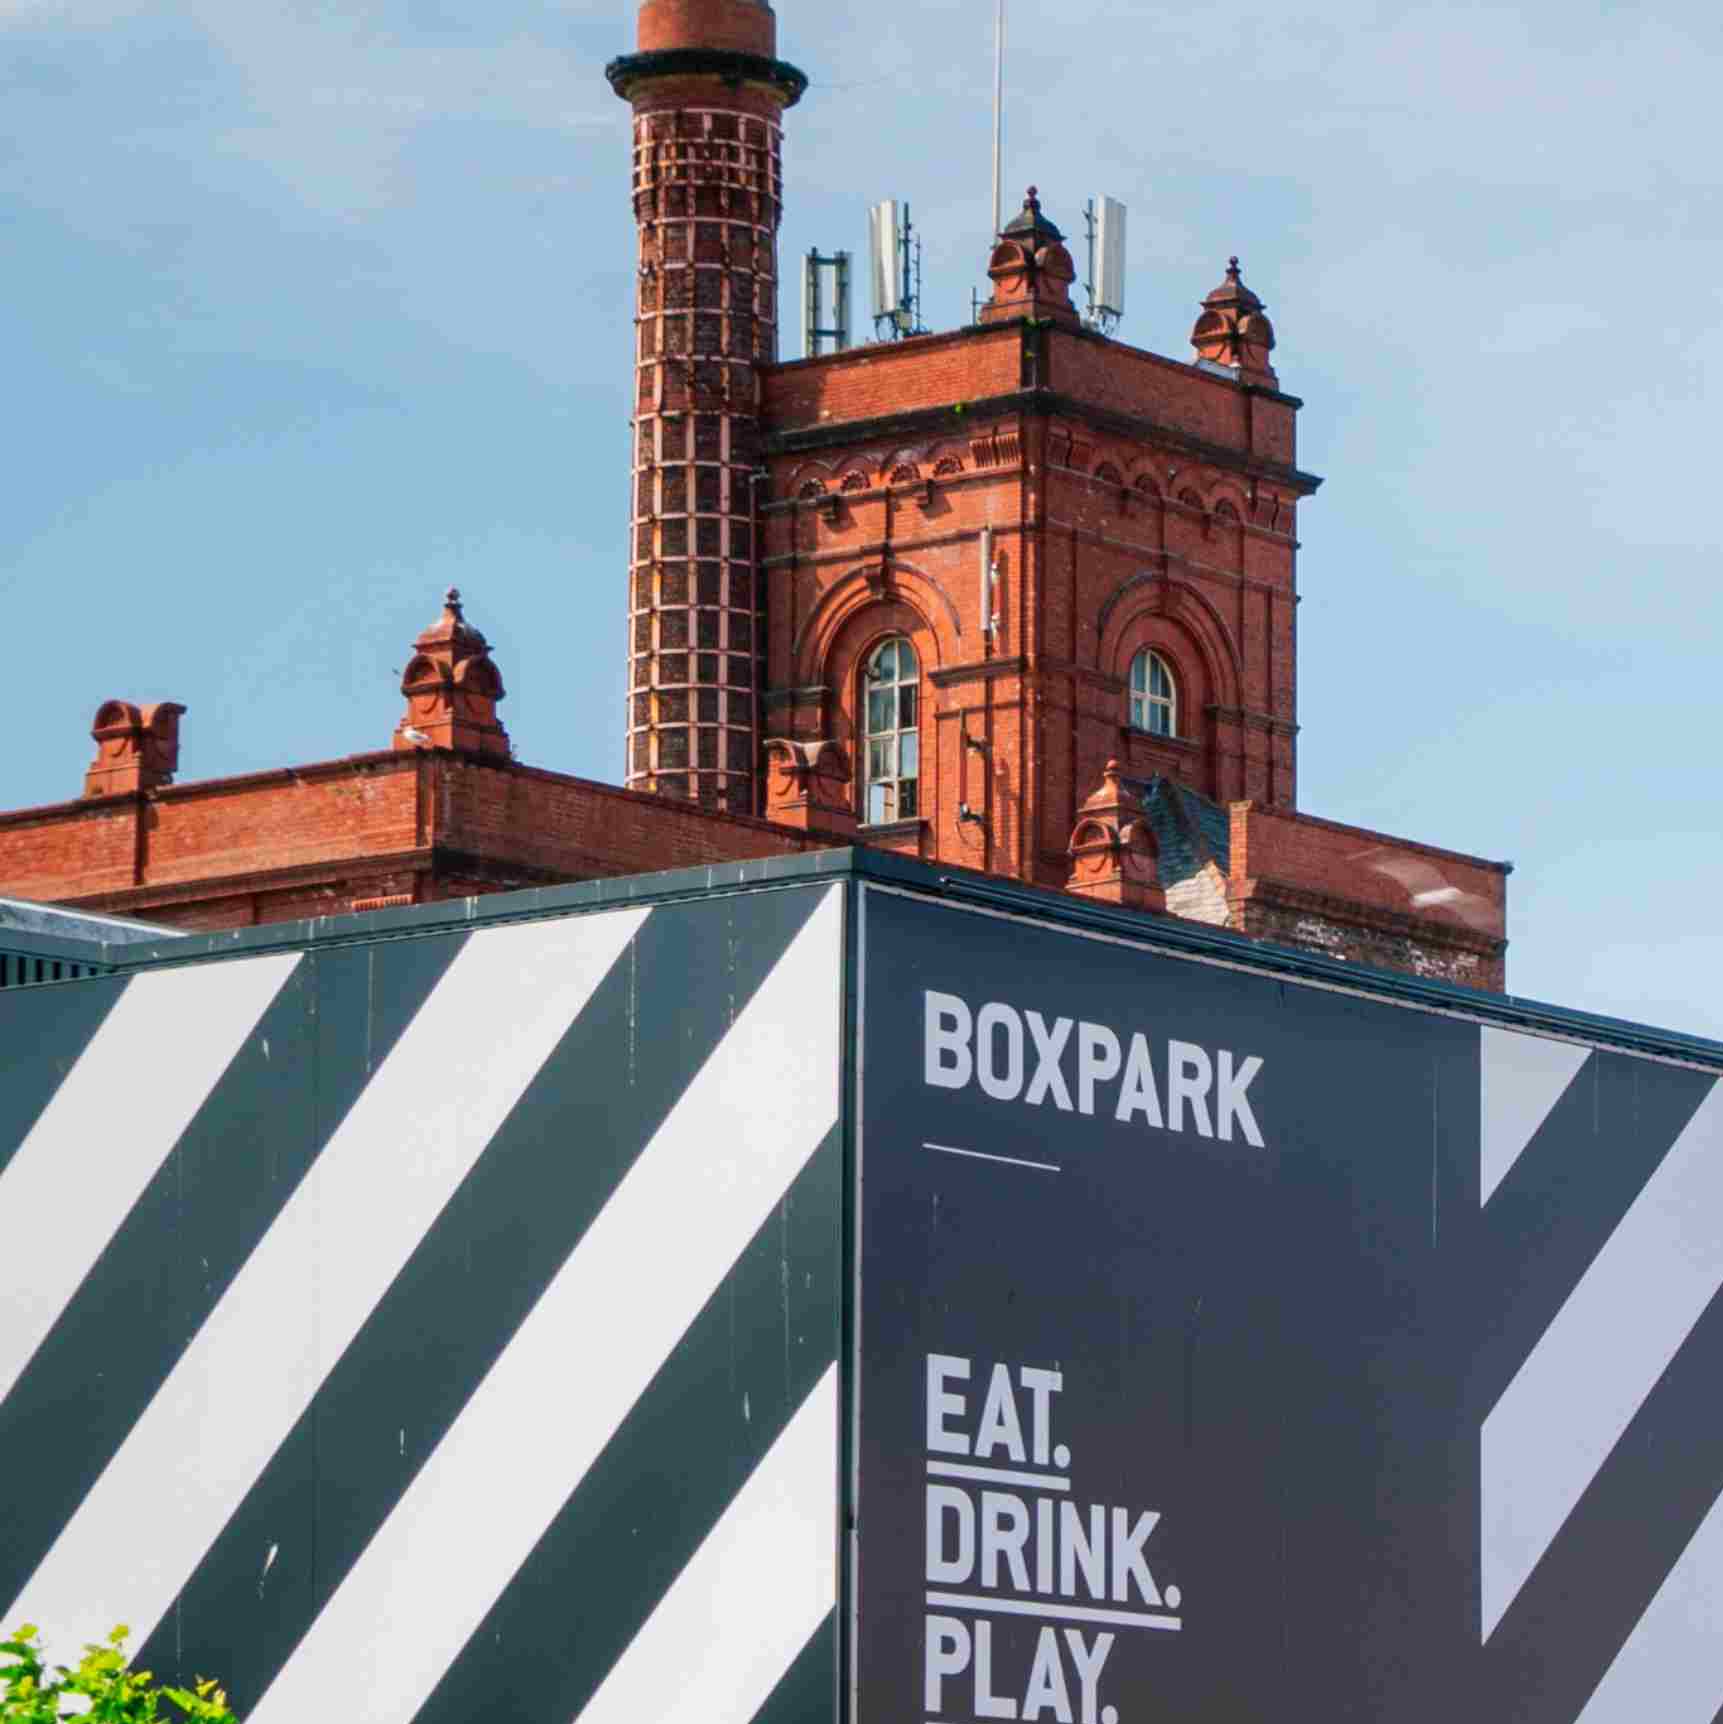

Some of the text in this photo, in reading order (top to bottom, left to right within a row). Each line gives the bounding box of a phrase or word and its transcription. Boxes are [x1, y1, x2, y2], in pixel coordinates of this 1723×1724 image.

[922, 989, 1265, 1149] BOXPARK
[926, 1353, 1071, 1468] EAT.
[925, 1484, 1182, 1609] DRINK.
